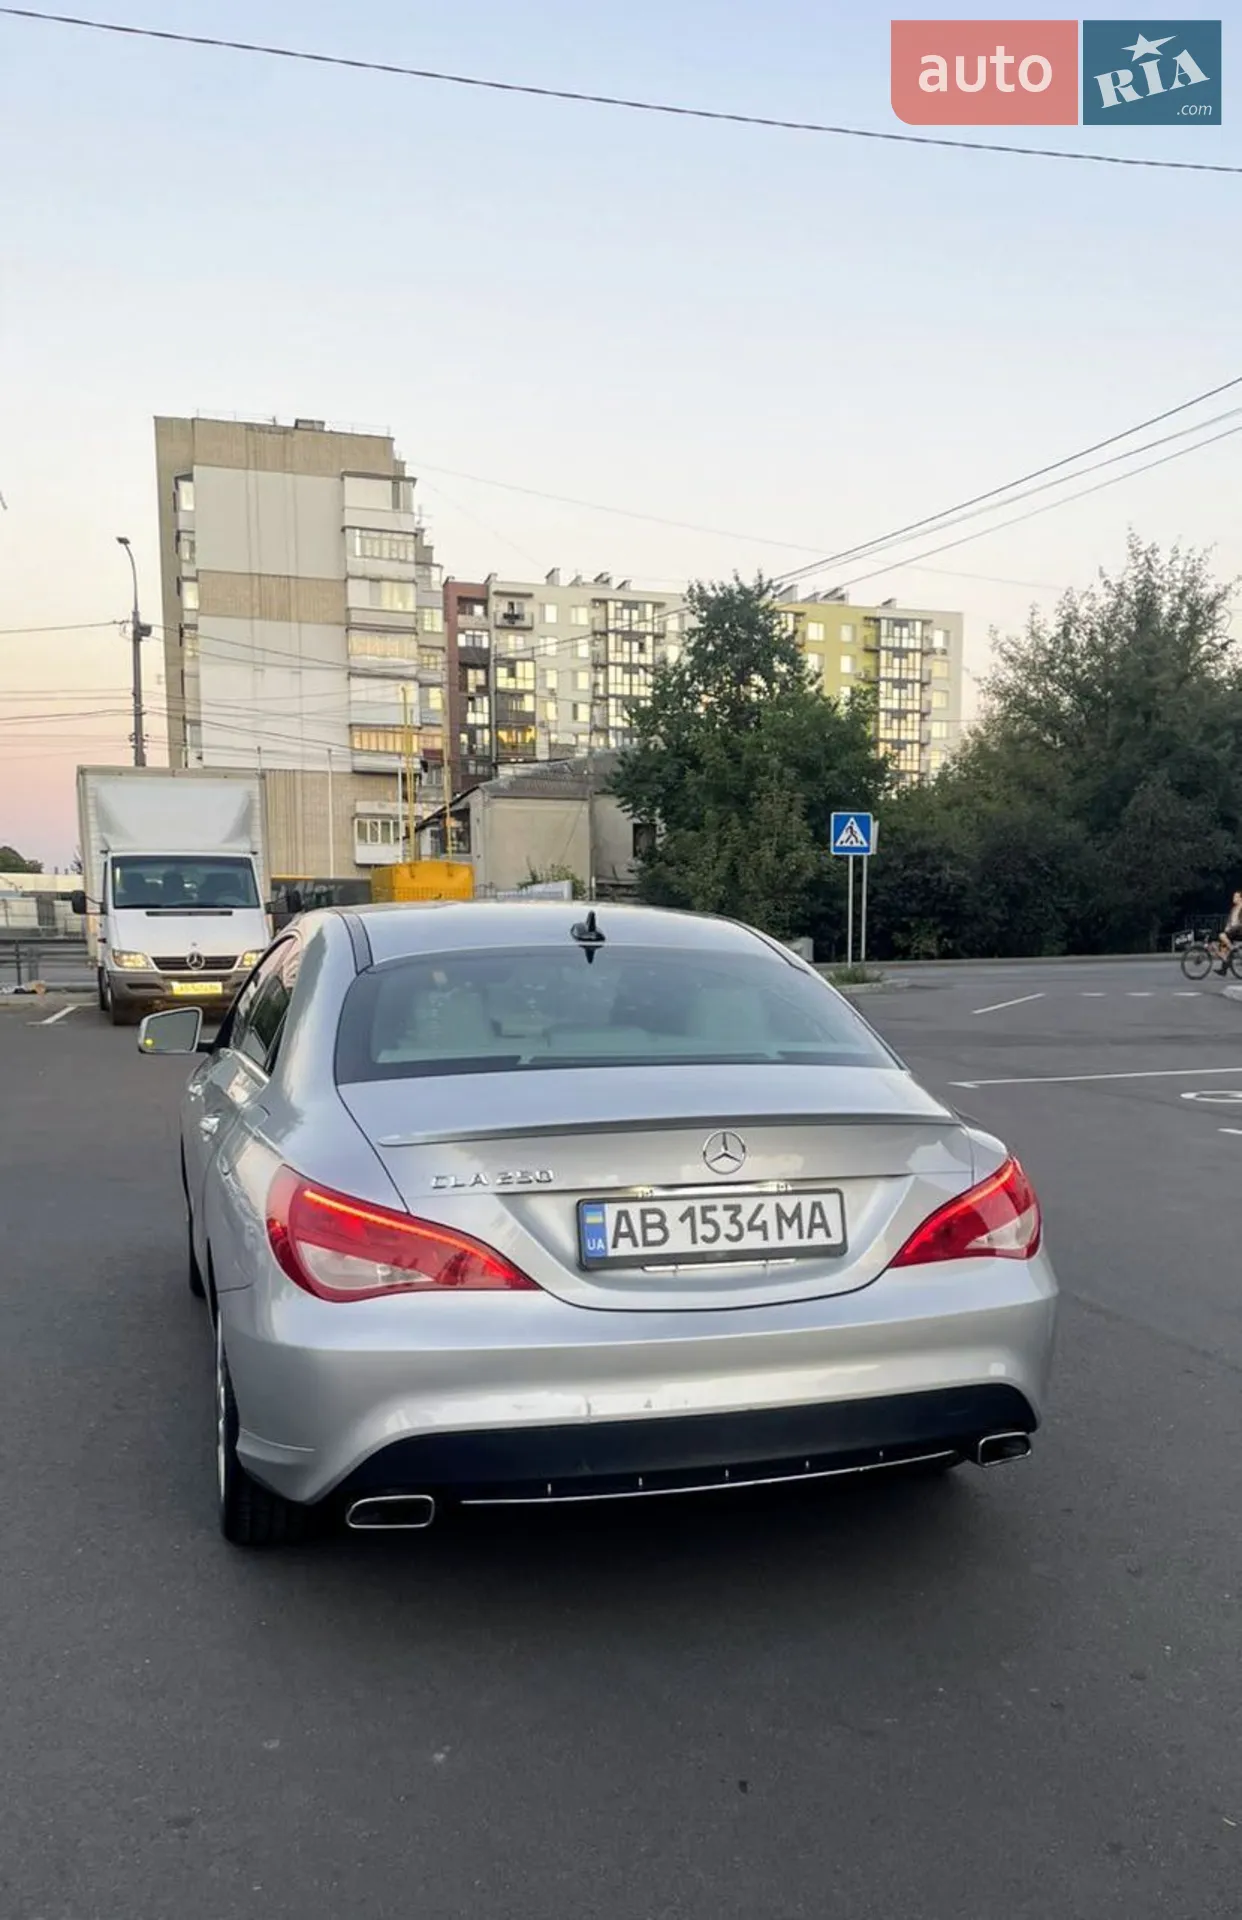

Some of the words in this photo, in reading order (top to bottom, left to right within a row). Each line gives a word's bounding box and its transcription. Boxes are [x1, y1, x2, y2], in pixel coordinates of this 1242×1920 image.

[431, 1173, 489, 1190] CLA
[496, 1169, 553, 1186] 250
[587, 1240, 605, 1250] UA
